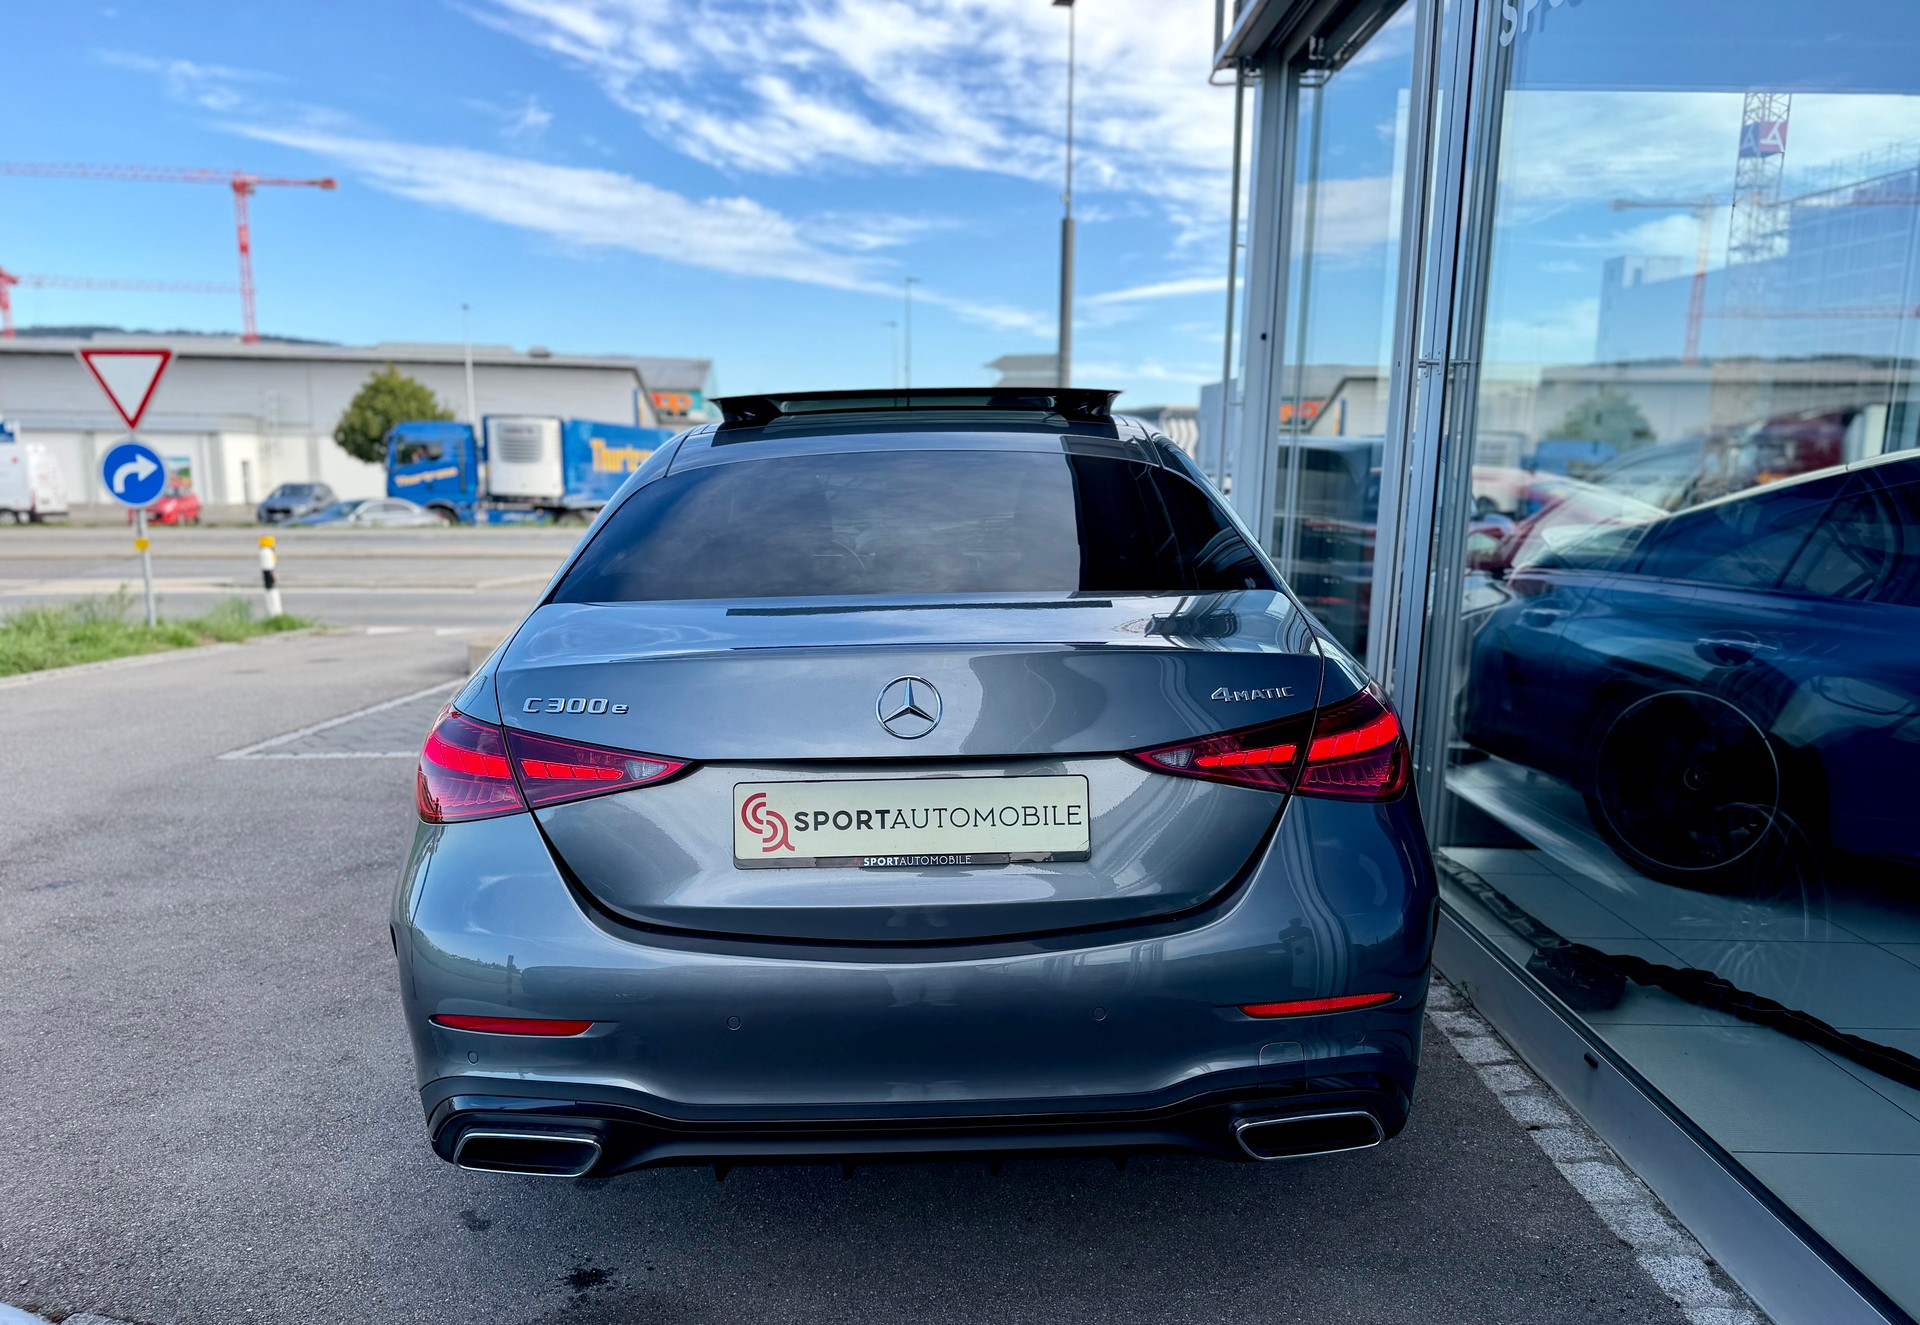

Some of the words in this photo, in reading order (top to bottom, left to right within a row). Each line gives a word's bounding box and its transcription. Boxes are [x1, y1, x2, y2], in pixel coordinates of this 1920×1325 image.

[1210, 686, 1295, 702] 4MATIC
[793, 805, 1082, 832] SPORTAUTOMOBILE
[863, 854, 972, 867] SPORTAUTOMOBILE
